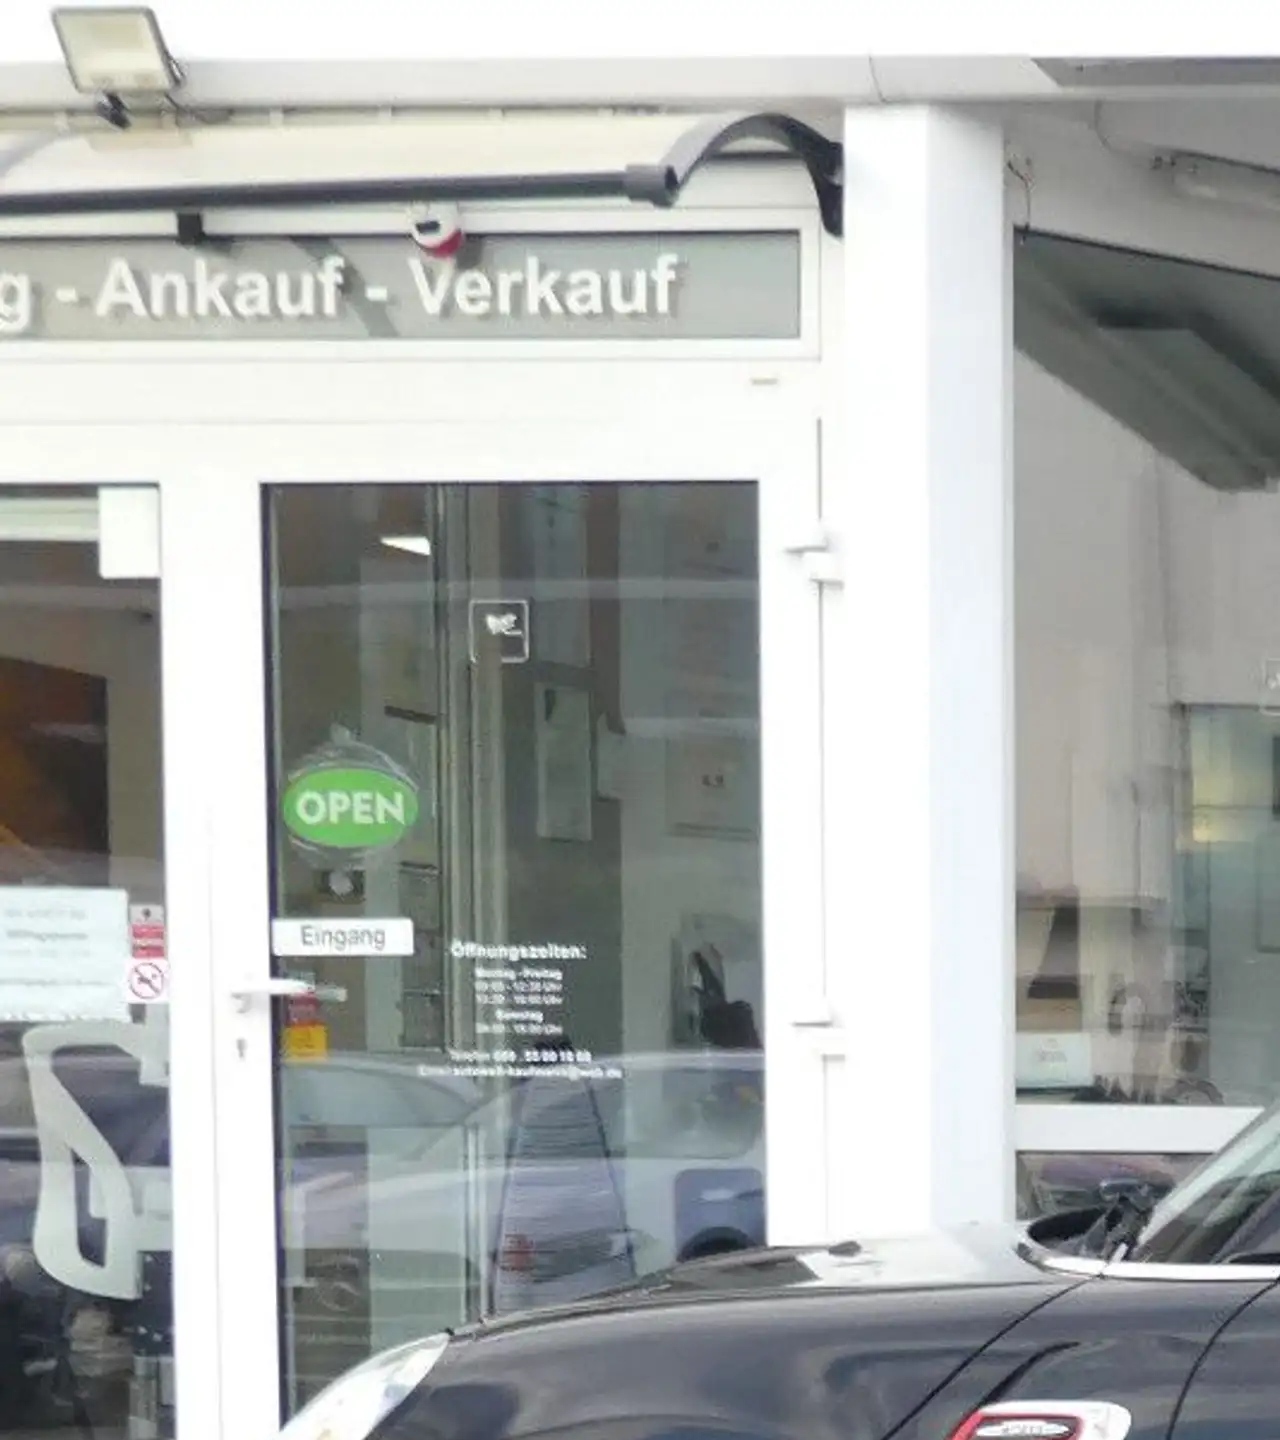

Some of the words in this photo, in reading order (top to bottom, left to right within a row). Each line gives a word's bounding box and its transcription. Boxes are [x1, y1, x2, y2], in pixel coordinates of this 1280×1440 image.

[96, 255, 344, 318] Ankauf
[407, 253, 678, 318] Verkauf
[296, 789, 406, 826] OPEN
[301, 925, 386, 951] Eingang
[451, 938, 587, 961] Öffnungszeiten:
